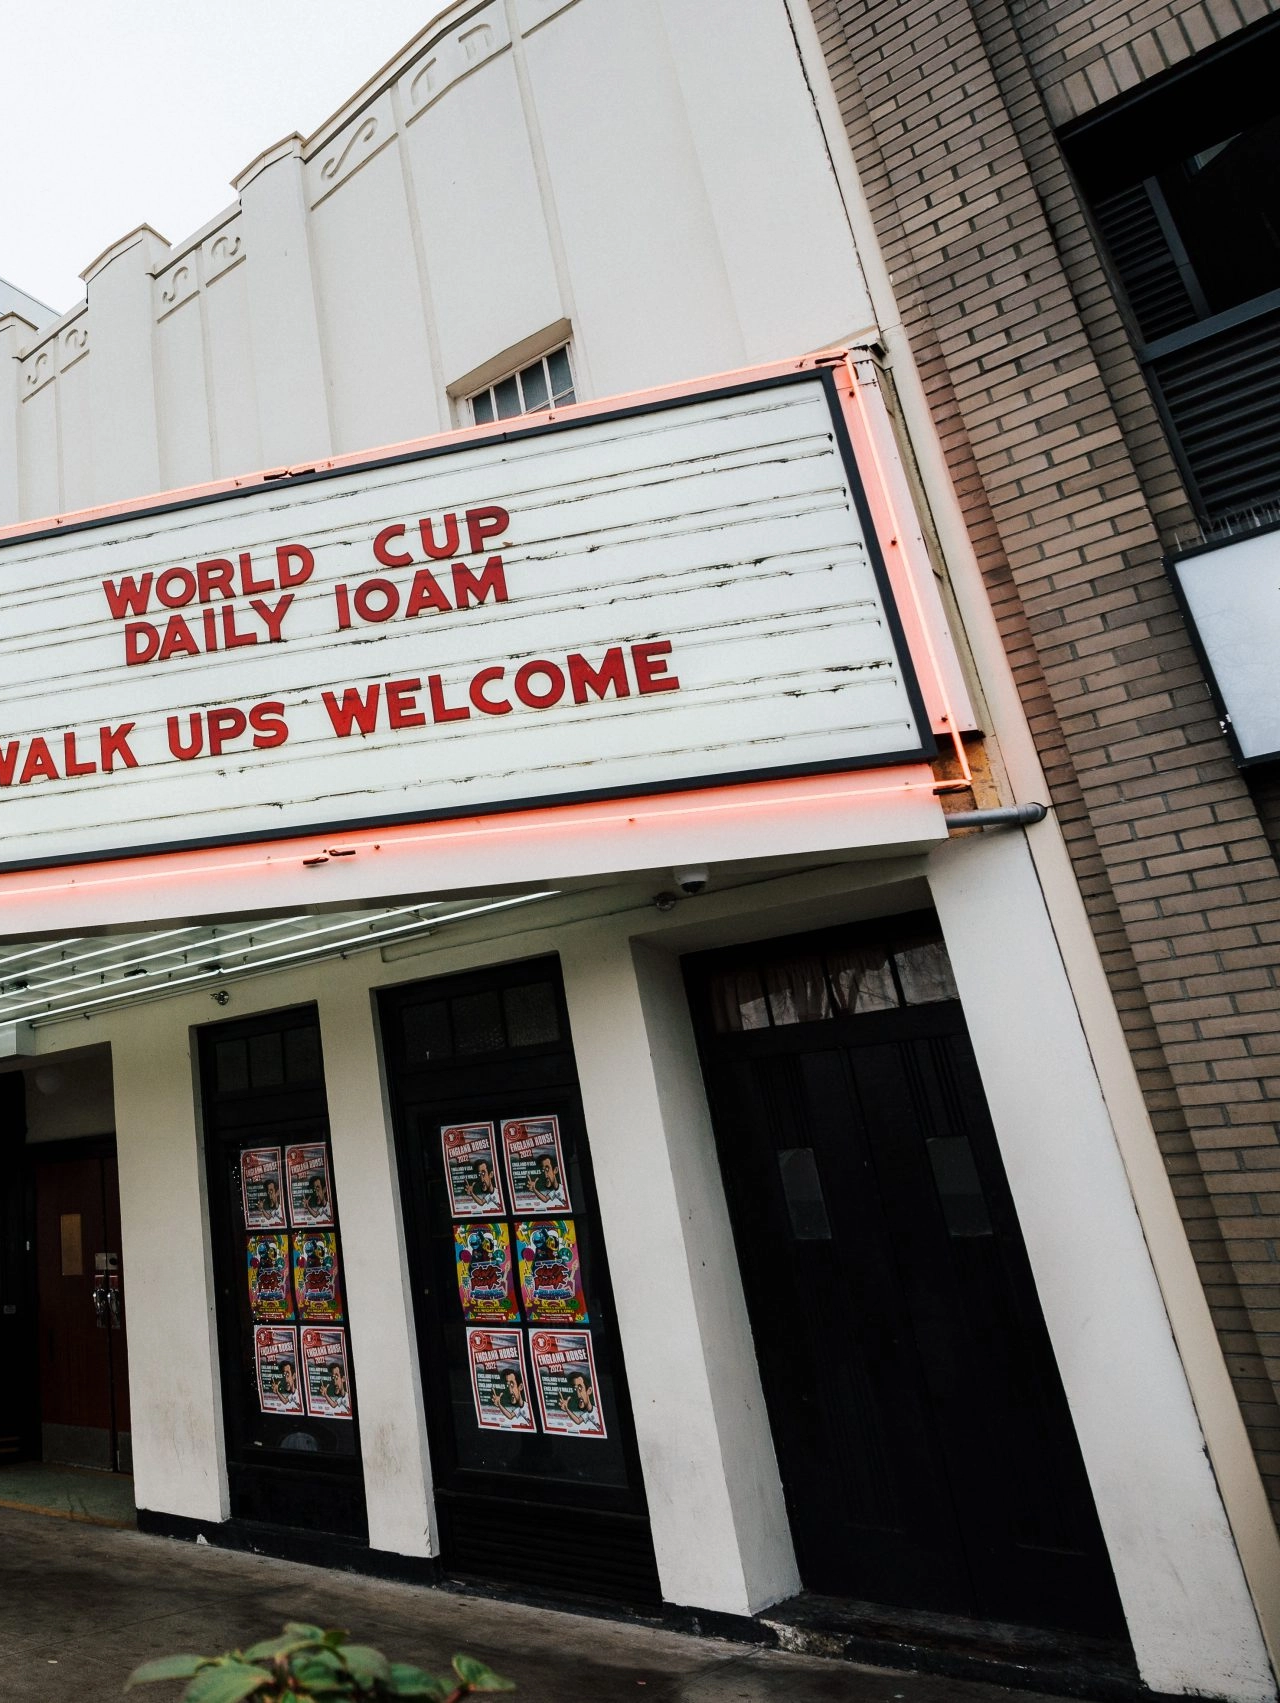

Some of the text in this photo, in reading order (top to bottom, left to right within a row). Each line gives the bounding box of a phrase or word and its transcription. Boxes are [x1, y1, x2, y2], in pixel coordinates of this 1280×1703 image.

[102, 505, 509, 620] WORLD CUP
[124, 593, 296, 666] DAILY
[167, 701, 289, 762] UPS
[321, 640, 680, 738] WELCOME
[448, 1139, 490, 1158] ENGLAND HOUSE
[510, 1132, 554, 1153] ENGLAND HOUSE
[475, 1347, 518, 1363] ENGLAND HOUSE
[537, 1349, 587, 1365] ENGLAND HOUSE
